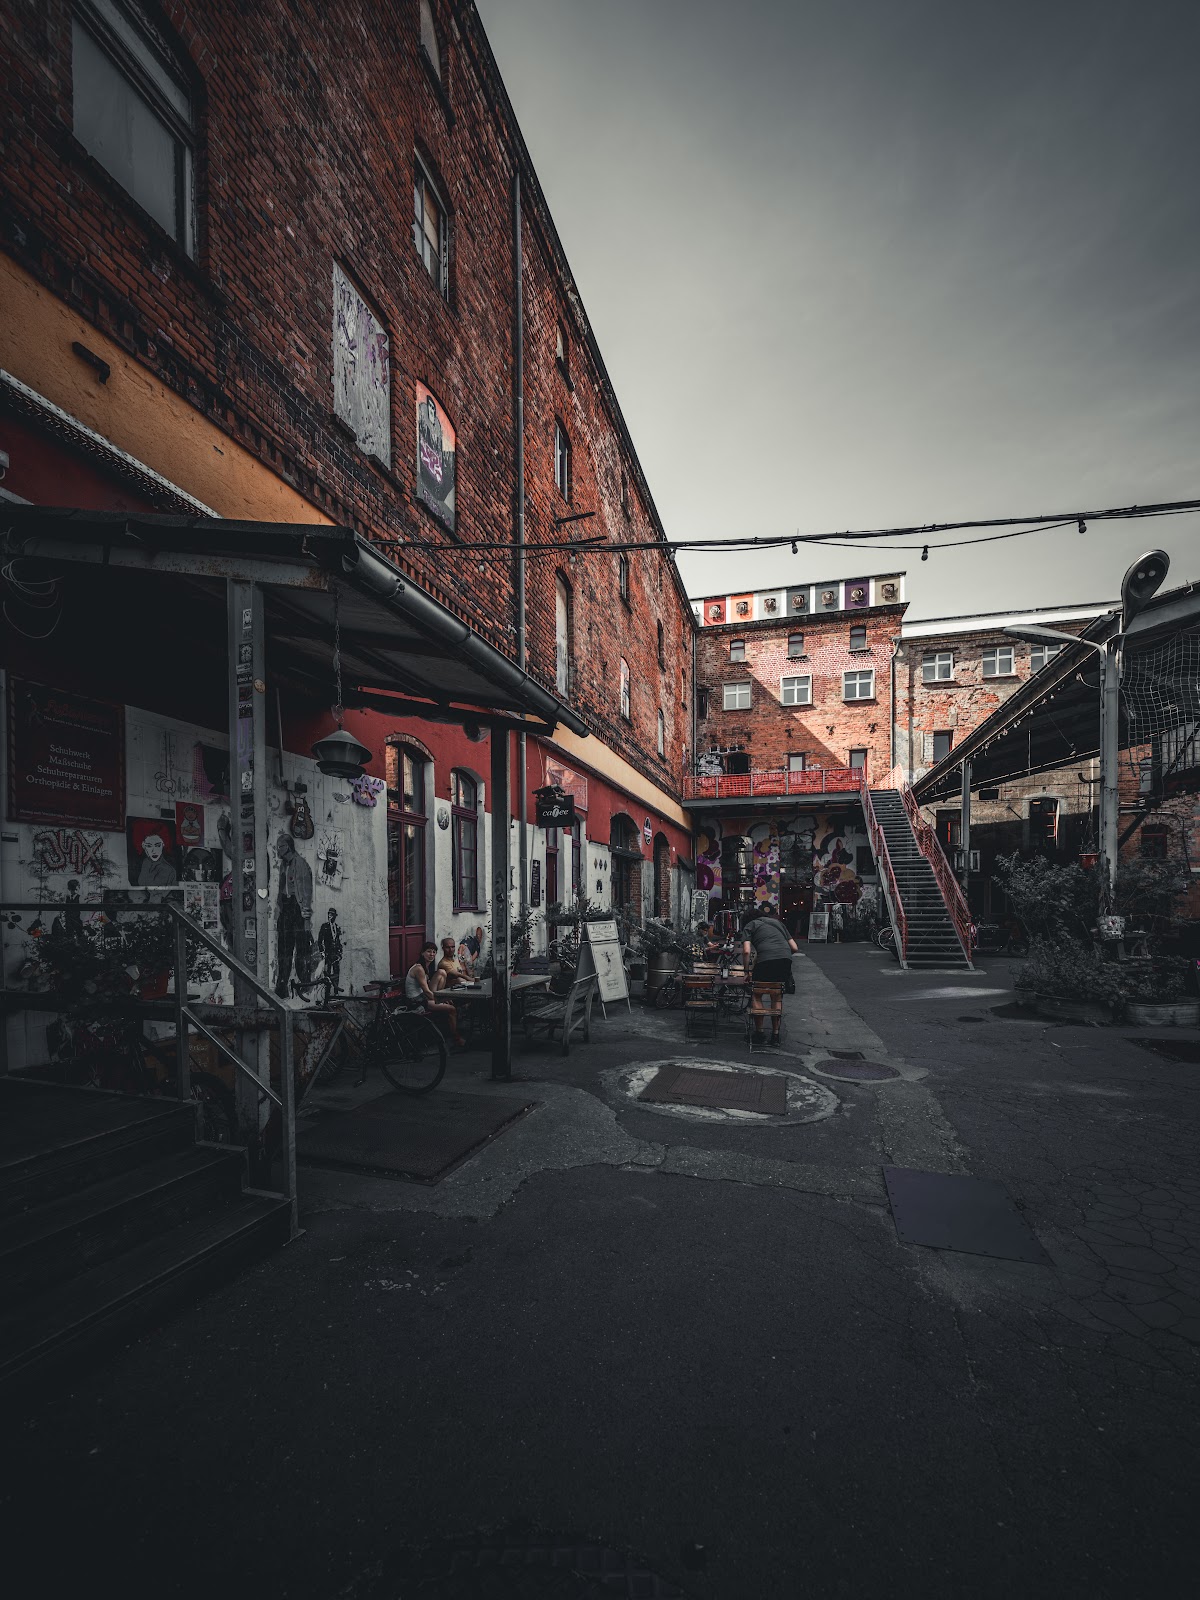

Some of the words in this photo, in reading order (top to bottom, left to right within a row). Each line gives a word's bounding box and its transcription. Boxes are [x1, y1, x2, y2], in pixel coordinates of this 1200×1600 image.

[49, 744, 91, 760] Schuhwerk
[49, 755, 92, 771] Maßschuhe
[37, 765, 103, 784] Schuhreparaturen
[26, 775, 72, 789] Orthopädie
[73, 783, 81, 791] &
[82, 783, 113, 797] Einlagen
